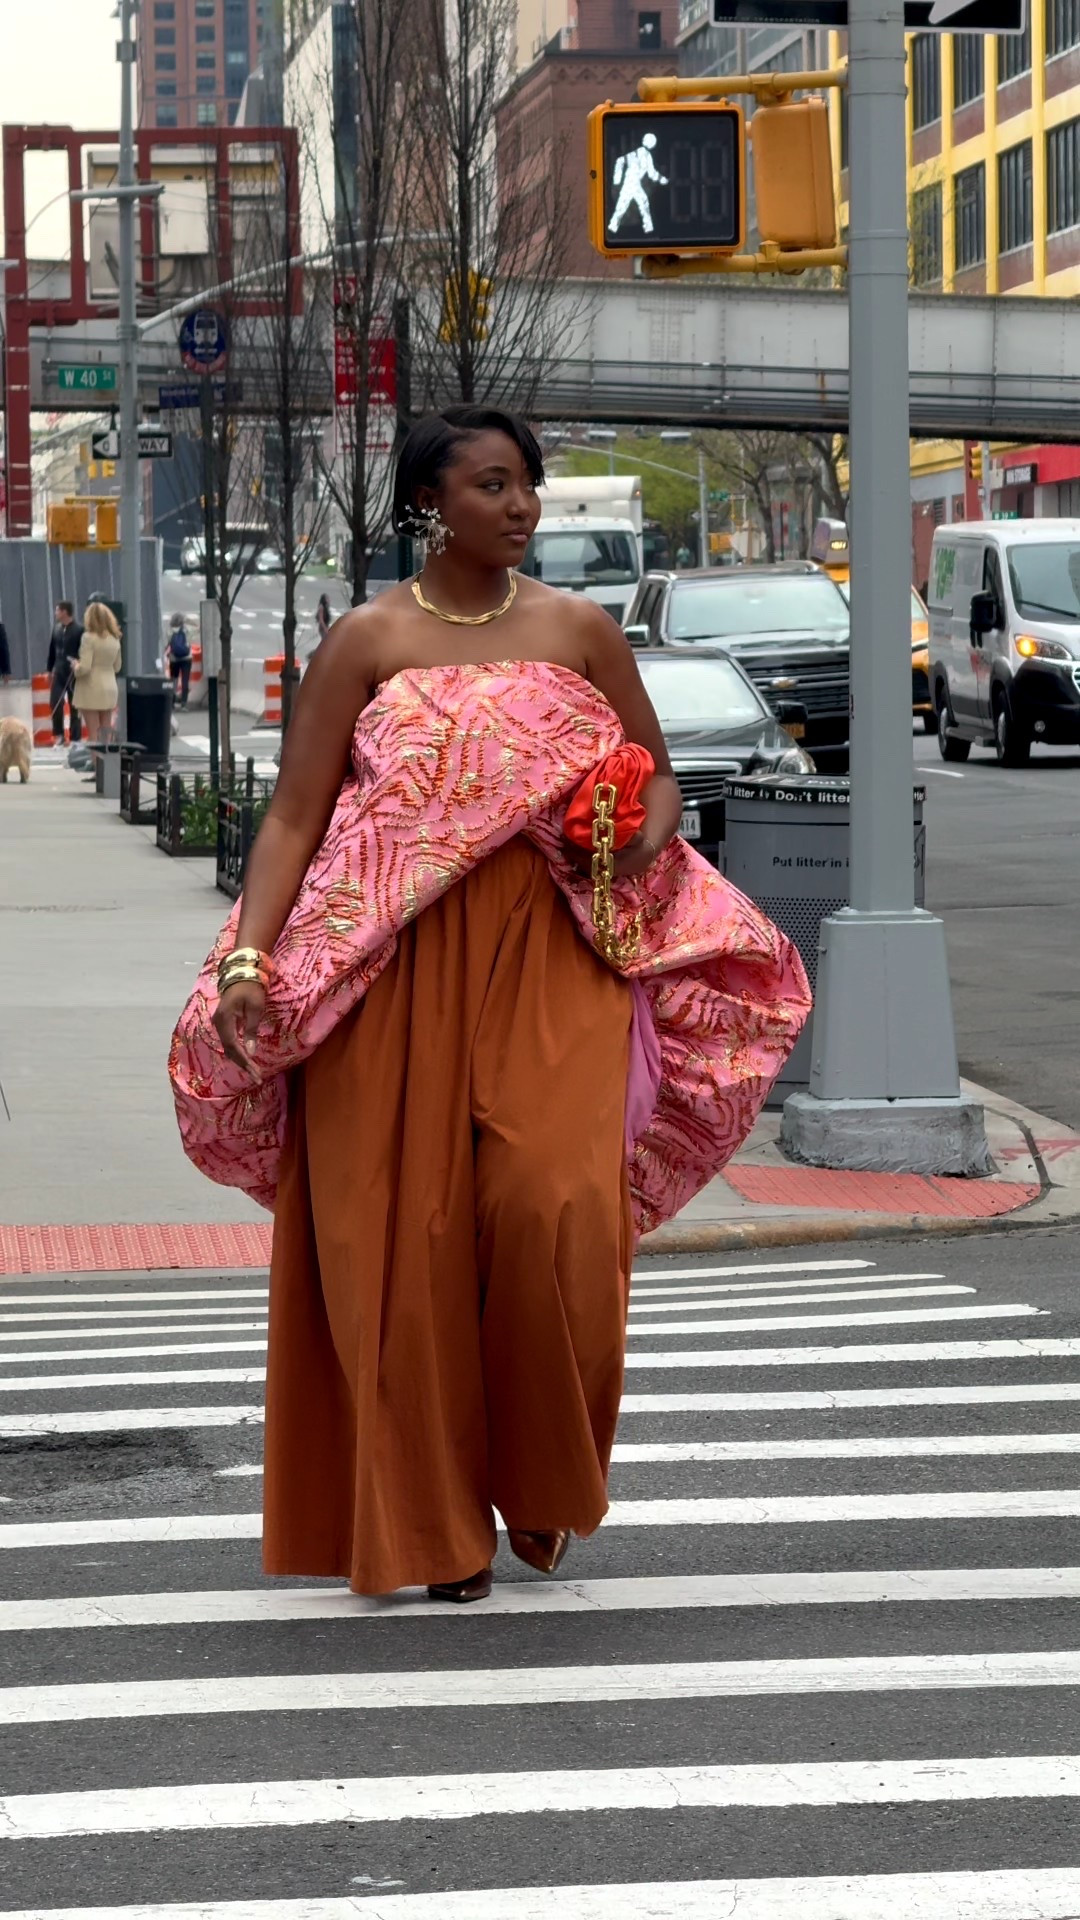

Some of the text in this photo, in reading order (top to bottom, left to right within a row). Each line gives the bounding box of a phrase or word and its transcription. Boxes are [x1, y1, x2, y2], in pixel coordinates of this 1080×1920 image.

[64, 370, 75, 387] W
[80, 370, 97, 387] 40
[140, 438, 165, 451] WAY
[734, 786, 755, 798] litter
[775, 790, 812, 802] Do't
[772, 856, 792, 867] Put
[796, 856, 828, 868] litter
